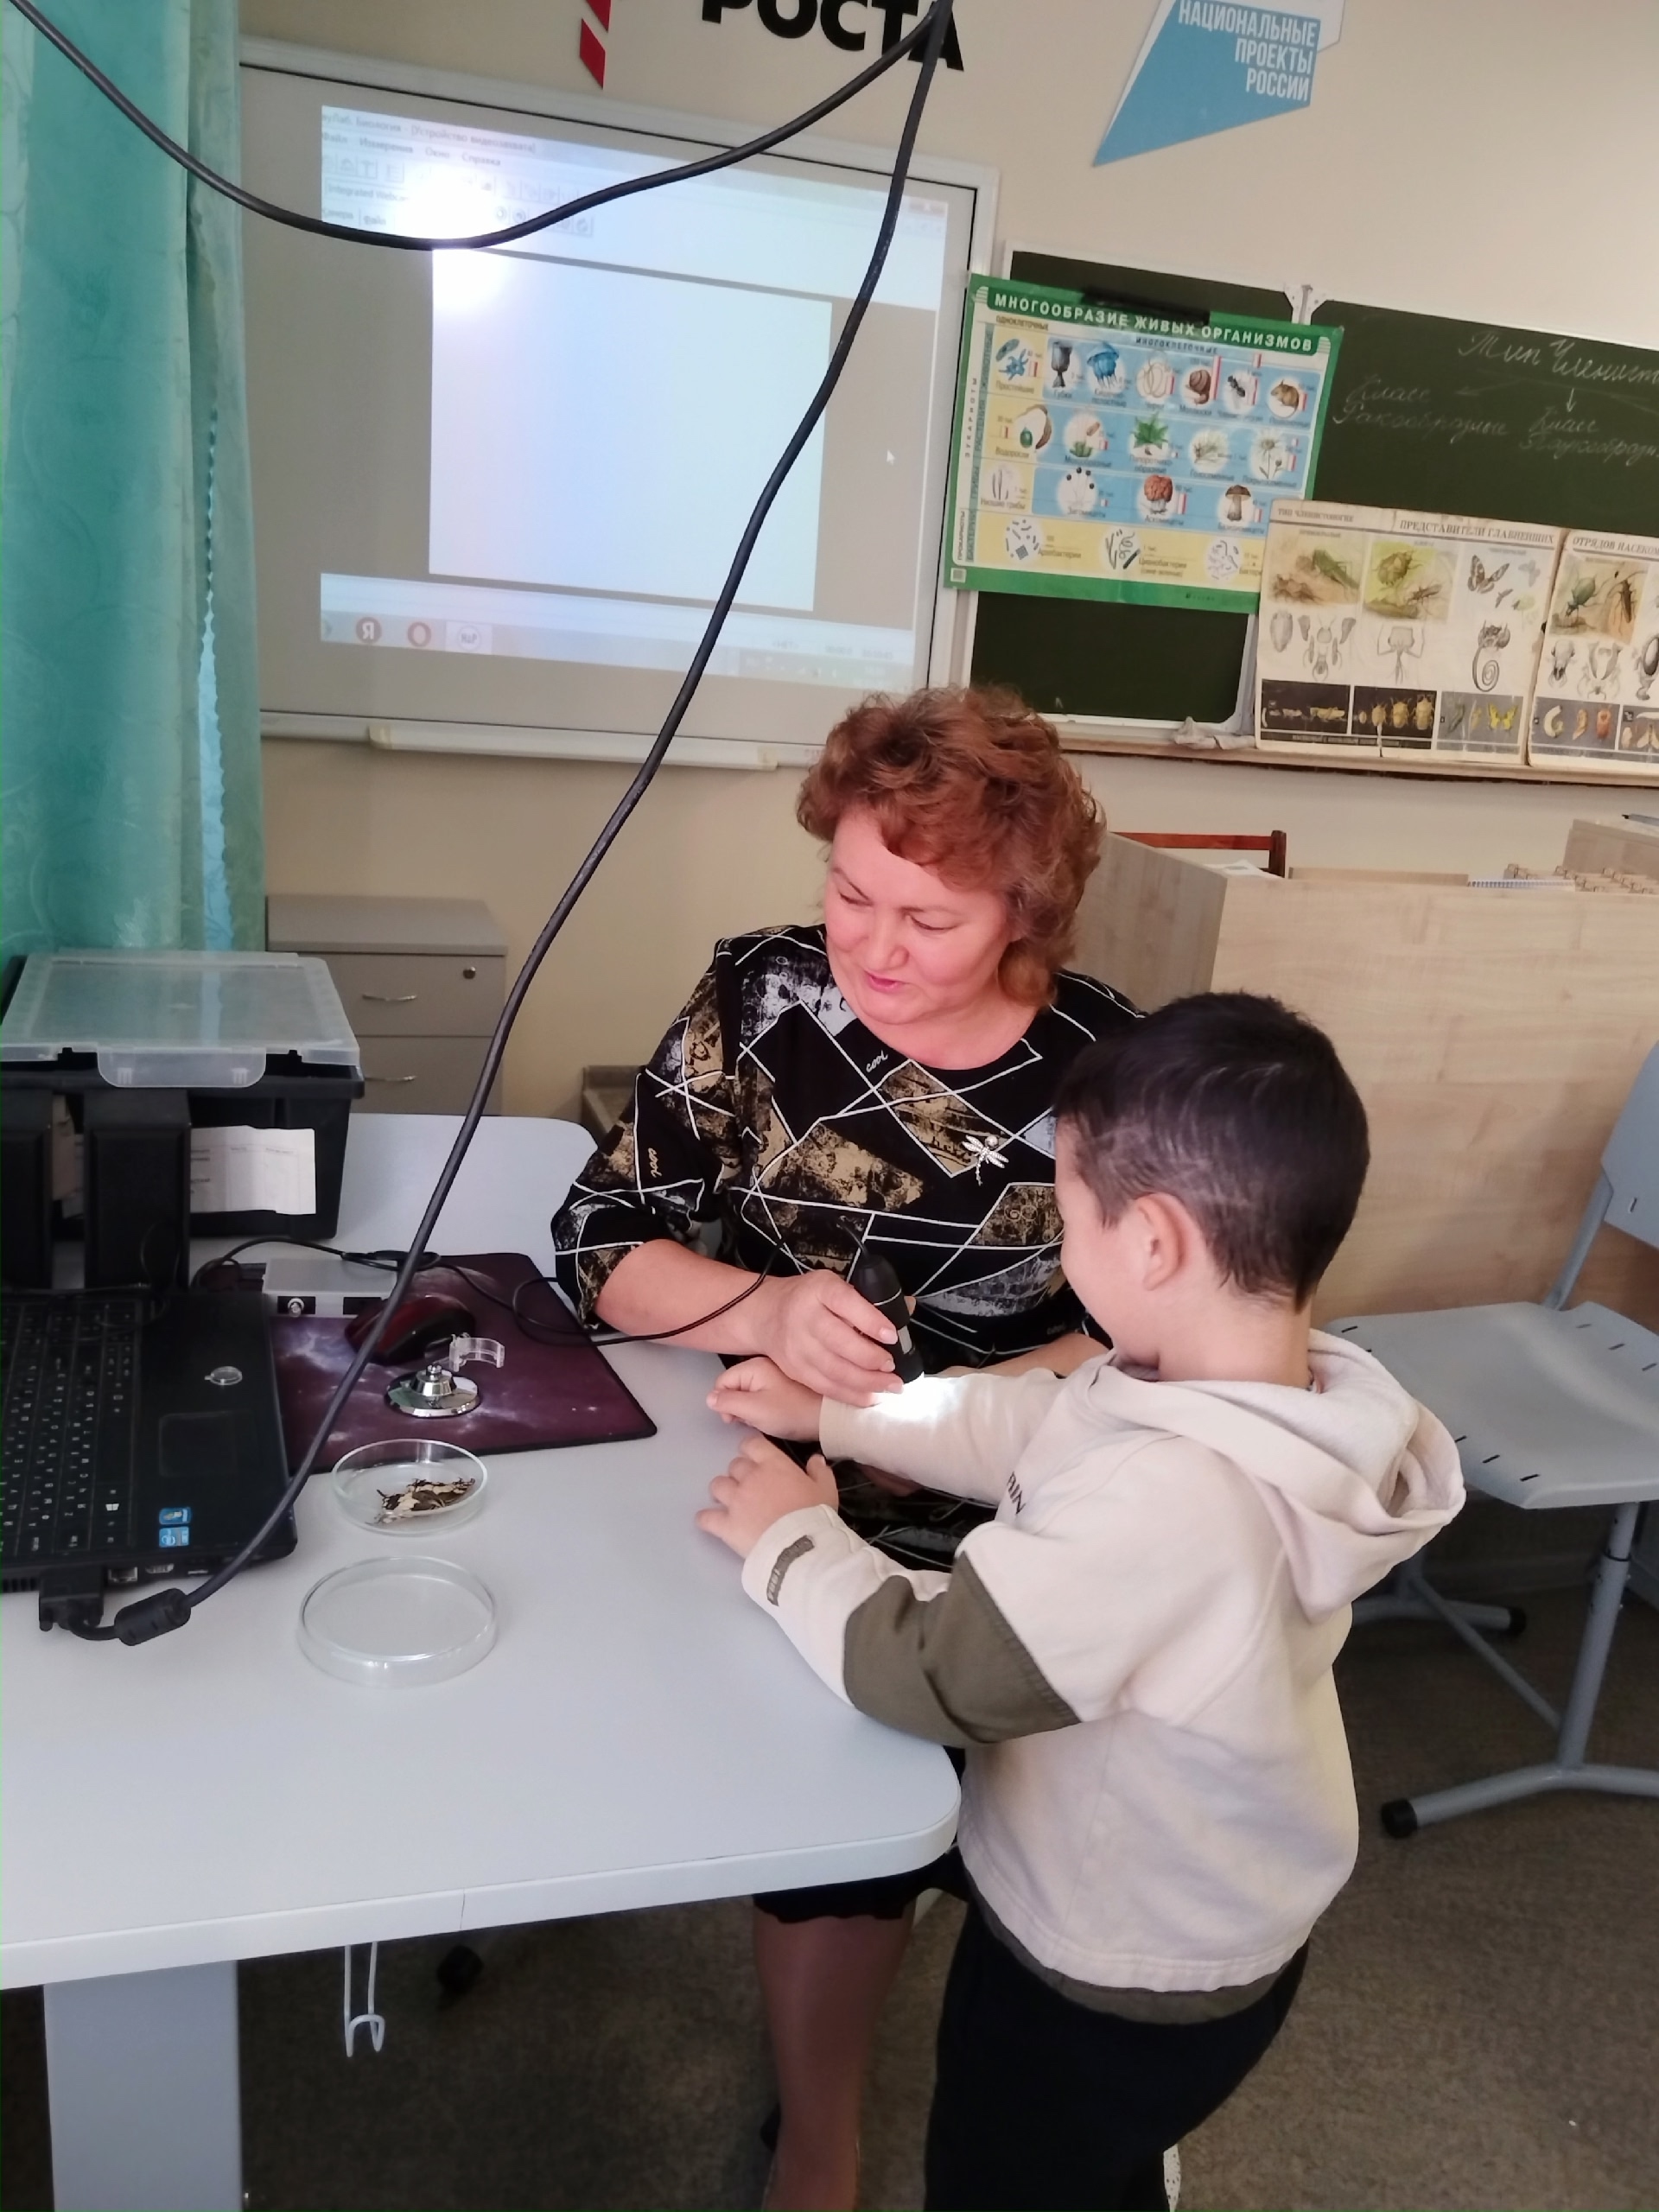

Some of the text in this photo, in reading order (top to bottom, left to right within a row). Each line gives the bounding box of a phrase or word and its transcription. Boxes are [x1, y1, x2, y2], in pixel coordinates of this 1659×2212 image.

[1178, 0, 1318, 48] НАЦИОНАЛЬНЫЕ
[1235, 38, 1313, 74] ПРОЕКТЫ
[1245, 67, 1310, 102] РОССИИ
[425, 147, 450, 159] Окно
[461, 151, 501, 166] Справка
[328, 185, 373, 199] Integrated
[995, 293, 1312, 352] МНОГООБРАЗИЕ ЖИВЫХ ОРГАНИЗМОВ
[995, 315, 1049, 332] ОДНОКЛЕТОЧНЫЕ
[1135, 334, 1217, 355] МНОГОКЛЕТОЧНЫЕ
[1459, 330, 1541, 365] Тип
[1399, 519, 1485, 536] ПРЕДСТАВИТЕЛИ
[1573, 536, 1616, 551] ОТРЯДОВ
